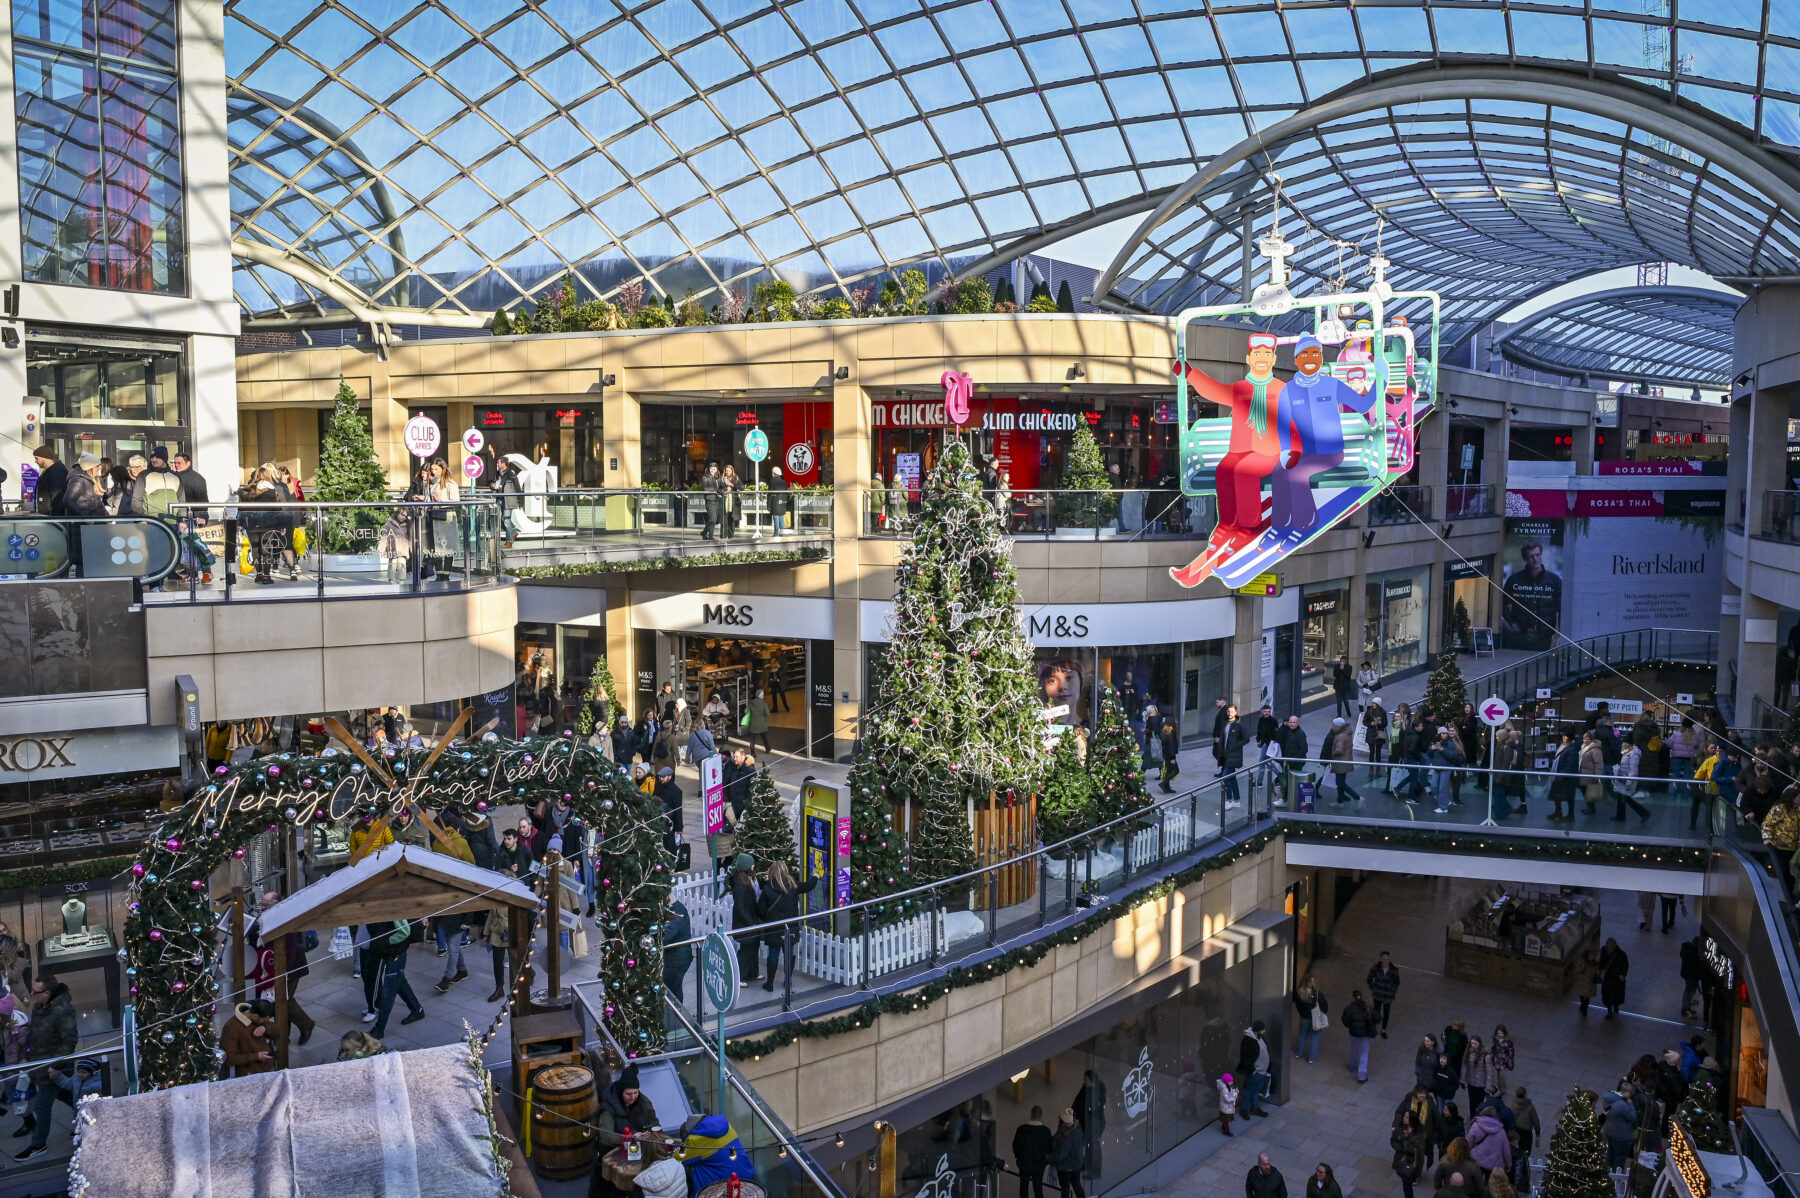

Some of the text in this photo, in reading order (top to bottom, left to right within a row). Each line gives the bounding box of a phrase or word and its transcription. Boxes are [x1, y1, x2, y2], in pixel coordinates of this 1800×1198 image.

[892, 403, 954, 426] CHICKE
[983, 413, 1014, 430] SLIM
[1018, 413, 1077, 430] CHICKENS
[411, 426, 434, 441] CLUB
[1615, 466, 1683, 474] ROSA'S THAI
[1590, 499, 1651, 507] ROSA'S THAI
[339, 528, 397, 540] ANGELICA
[1512, 583, 1533, 591] Come
[702, 603, 754, 627] M&S
[1029, 615, 1089, 638] M&S
[638, 671, 653, 679] M&S
[815, 684, 832, 693] M&S
[1621, 704, 1639, 712] PISTE
[188, 706, 197, 731] Ground
[192, 735, 580, 828] Merry Christmas Leeds!
[708, 804, 723, 827] SKI
[65, 881, 88, 894] ROX
